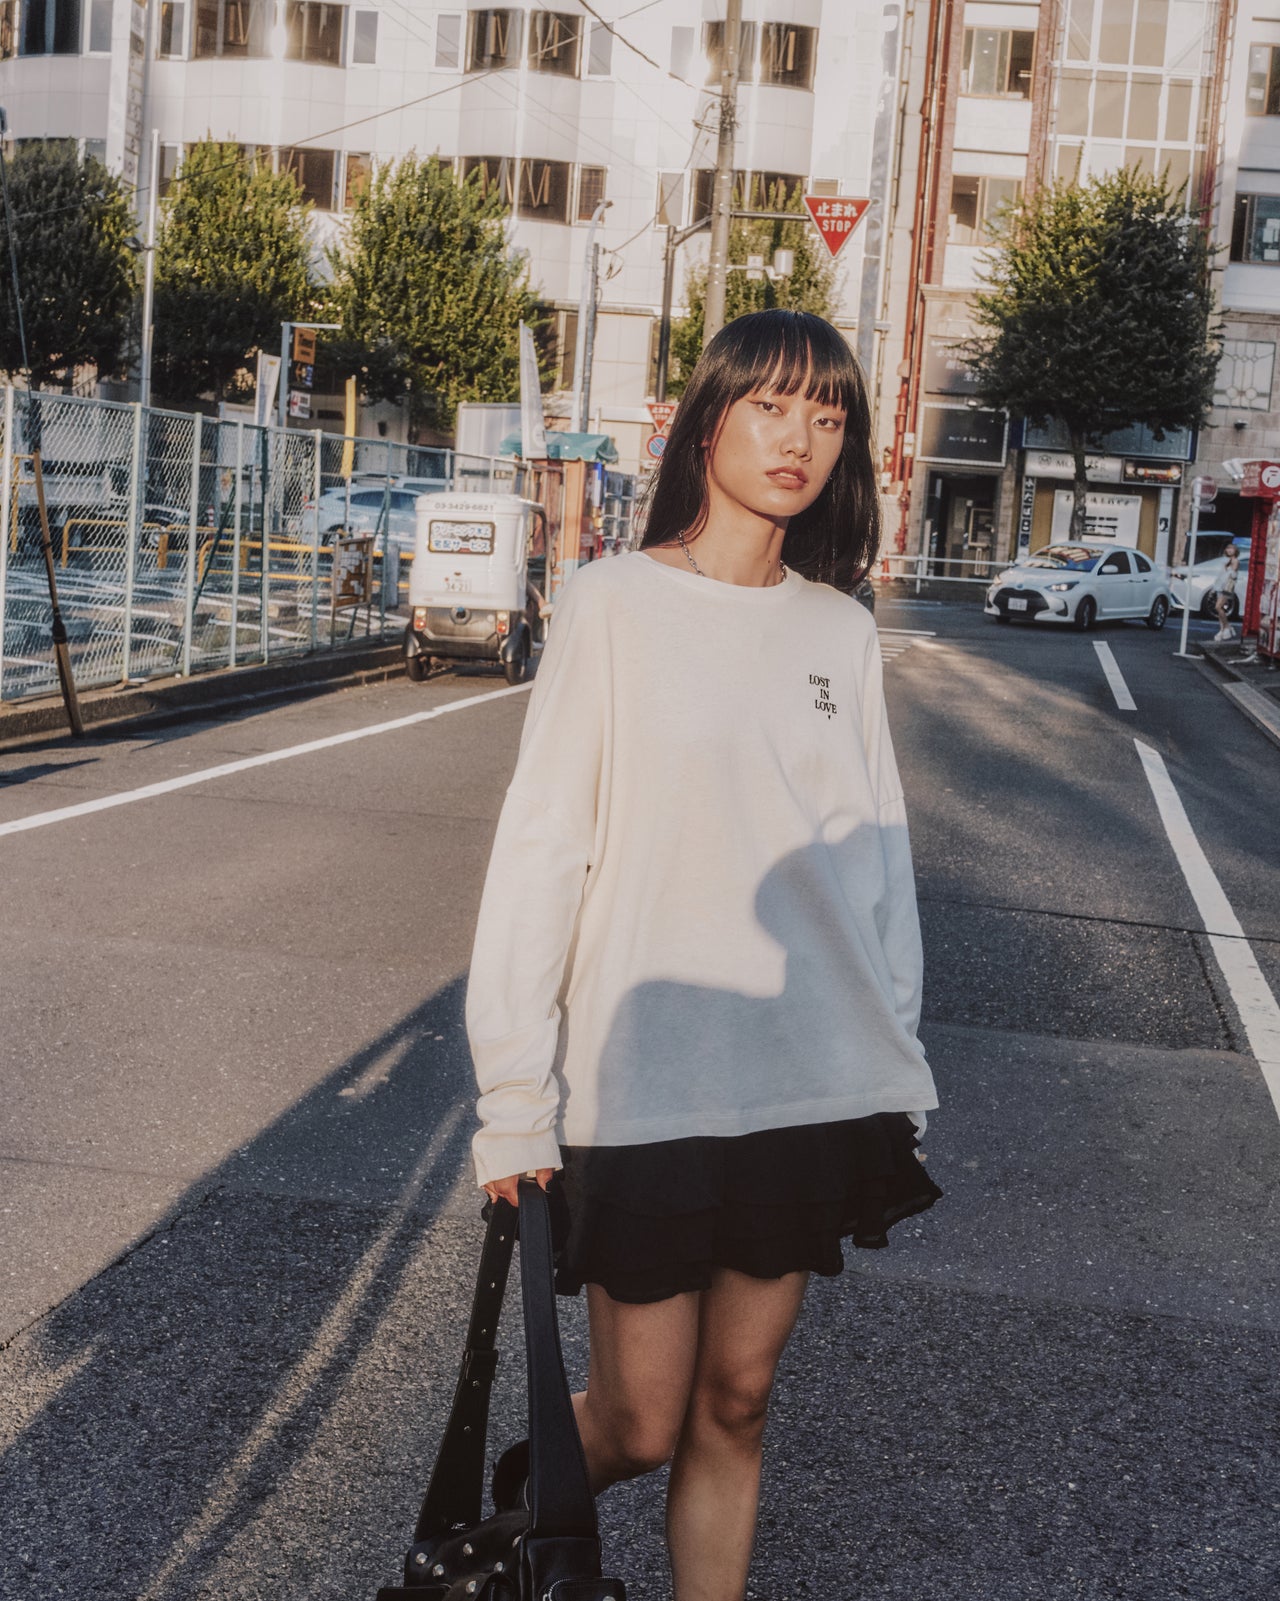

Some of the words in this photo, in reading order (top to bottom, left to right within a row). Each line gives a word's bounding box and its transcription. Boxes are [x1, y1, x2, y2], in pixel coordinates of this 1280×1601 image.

[816, 202, 858, 218] 止まれ
[822, 219, 852, 232] STOP
[809, 674, 830, 688] LOST
[820, 689, 830, 700] IN
[815, 699, 837, 714] LOVE
